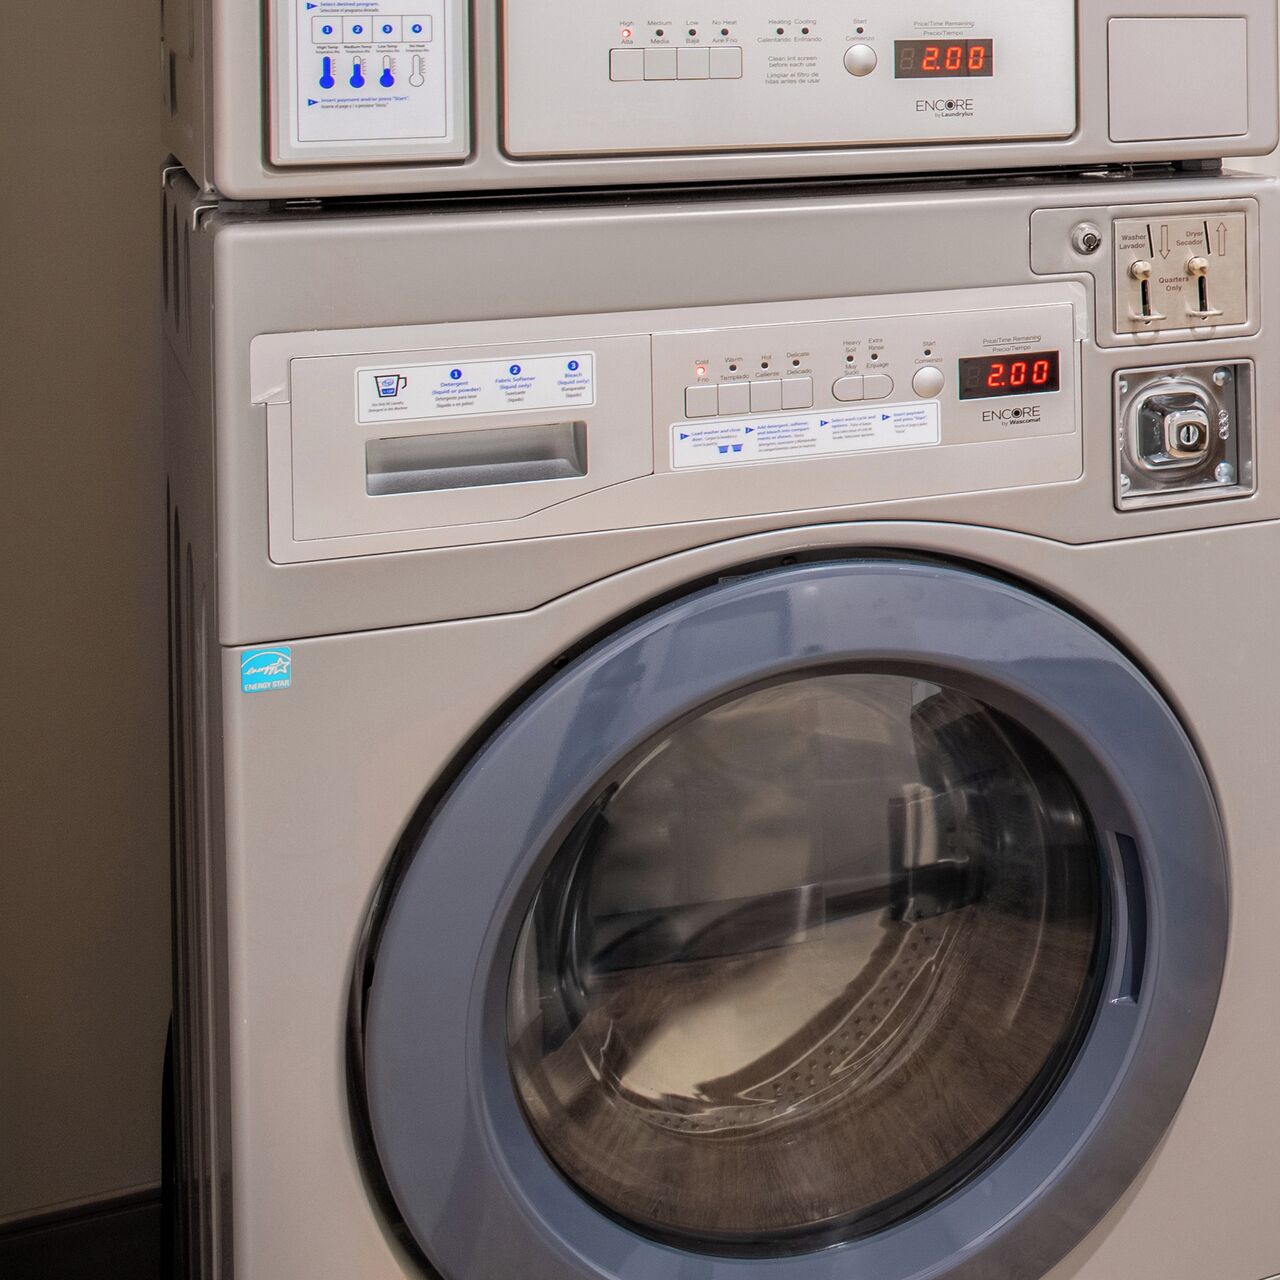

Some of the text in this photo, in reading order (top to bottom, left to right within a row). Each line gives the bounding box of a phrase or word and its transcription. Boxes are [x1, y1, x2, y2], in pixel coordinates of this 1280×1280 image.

[922, 46, 985, 70] 2.00
[916, 99, 973, 111] ENCORE
[720, 373, 749, 381] Templado
[988, 360, 1048, 386] 2.00
[982, 406, 1040, 422] ENCORE
